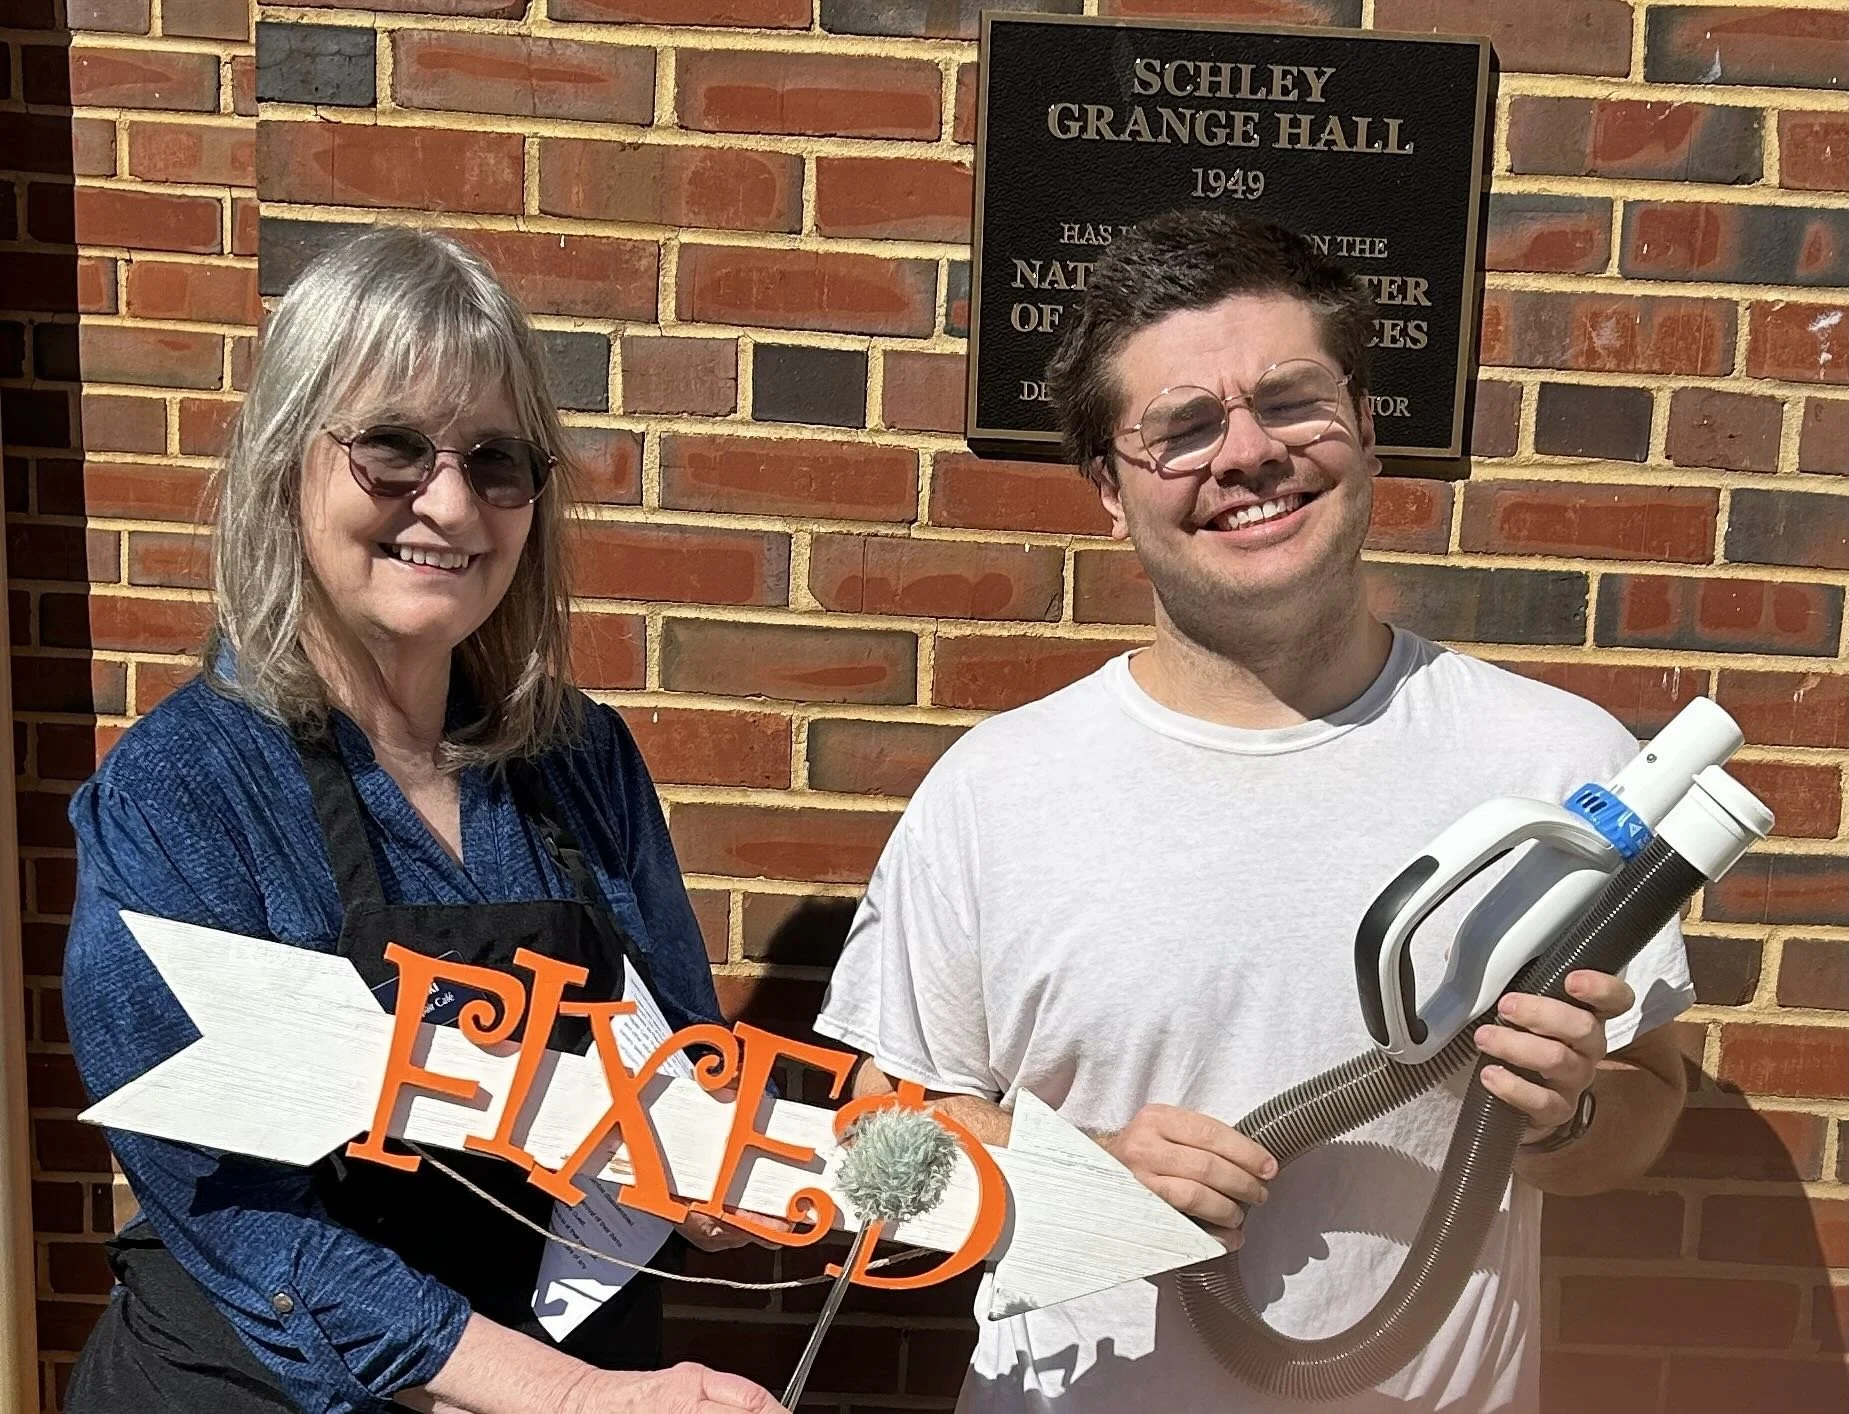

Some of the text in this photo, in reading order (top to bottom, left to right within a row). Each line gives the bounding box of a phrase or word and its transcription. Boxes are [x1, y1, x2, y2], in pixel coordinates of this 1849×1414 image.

[1133, 57, 1336, 102] SCHLEY
[1047, 102, 1414, 154] GRANGE HALL
[1190, 167, 1265, 199] 1949
[1059, 222, 1112, 246] HAS
[1336, 236, 1388, 258] THE
[1011, 258, 1097, 291] NAT
[1010, 302, 1063, 333] OF
[346, 941, 1007, 1290] FIXED
